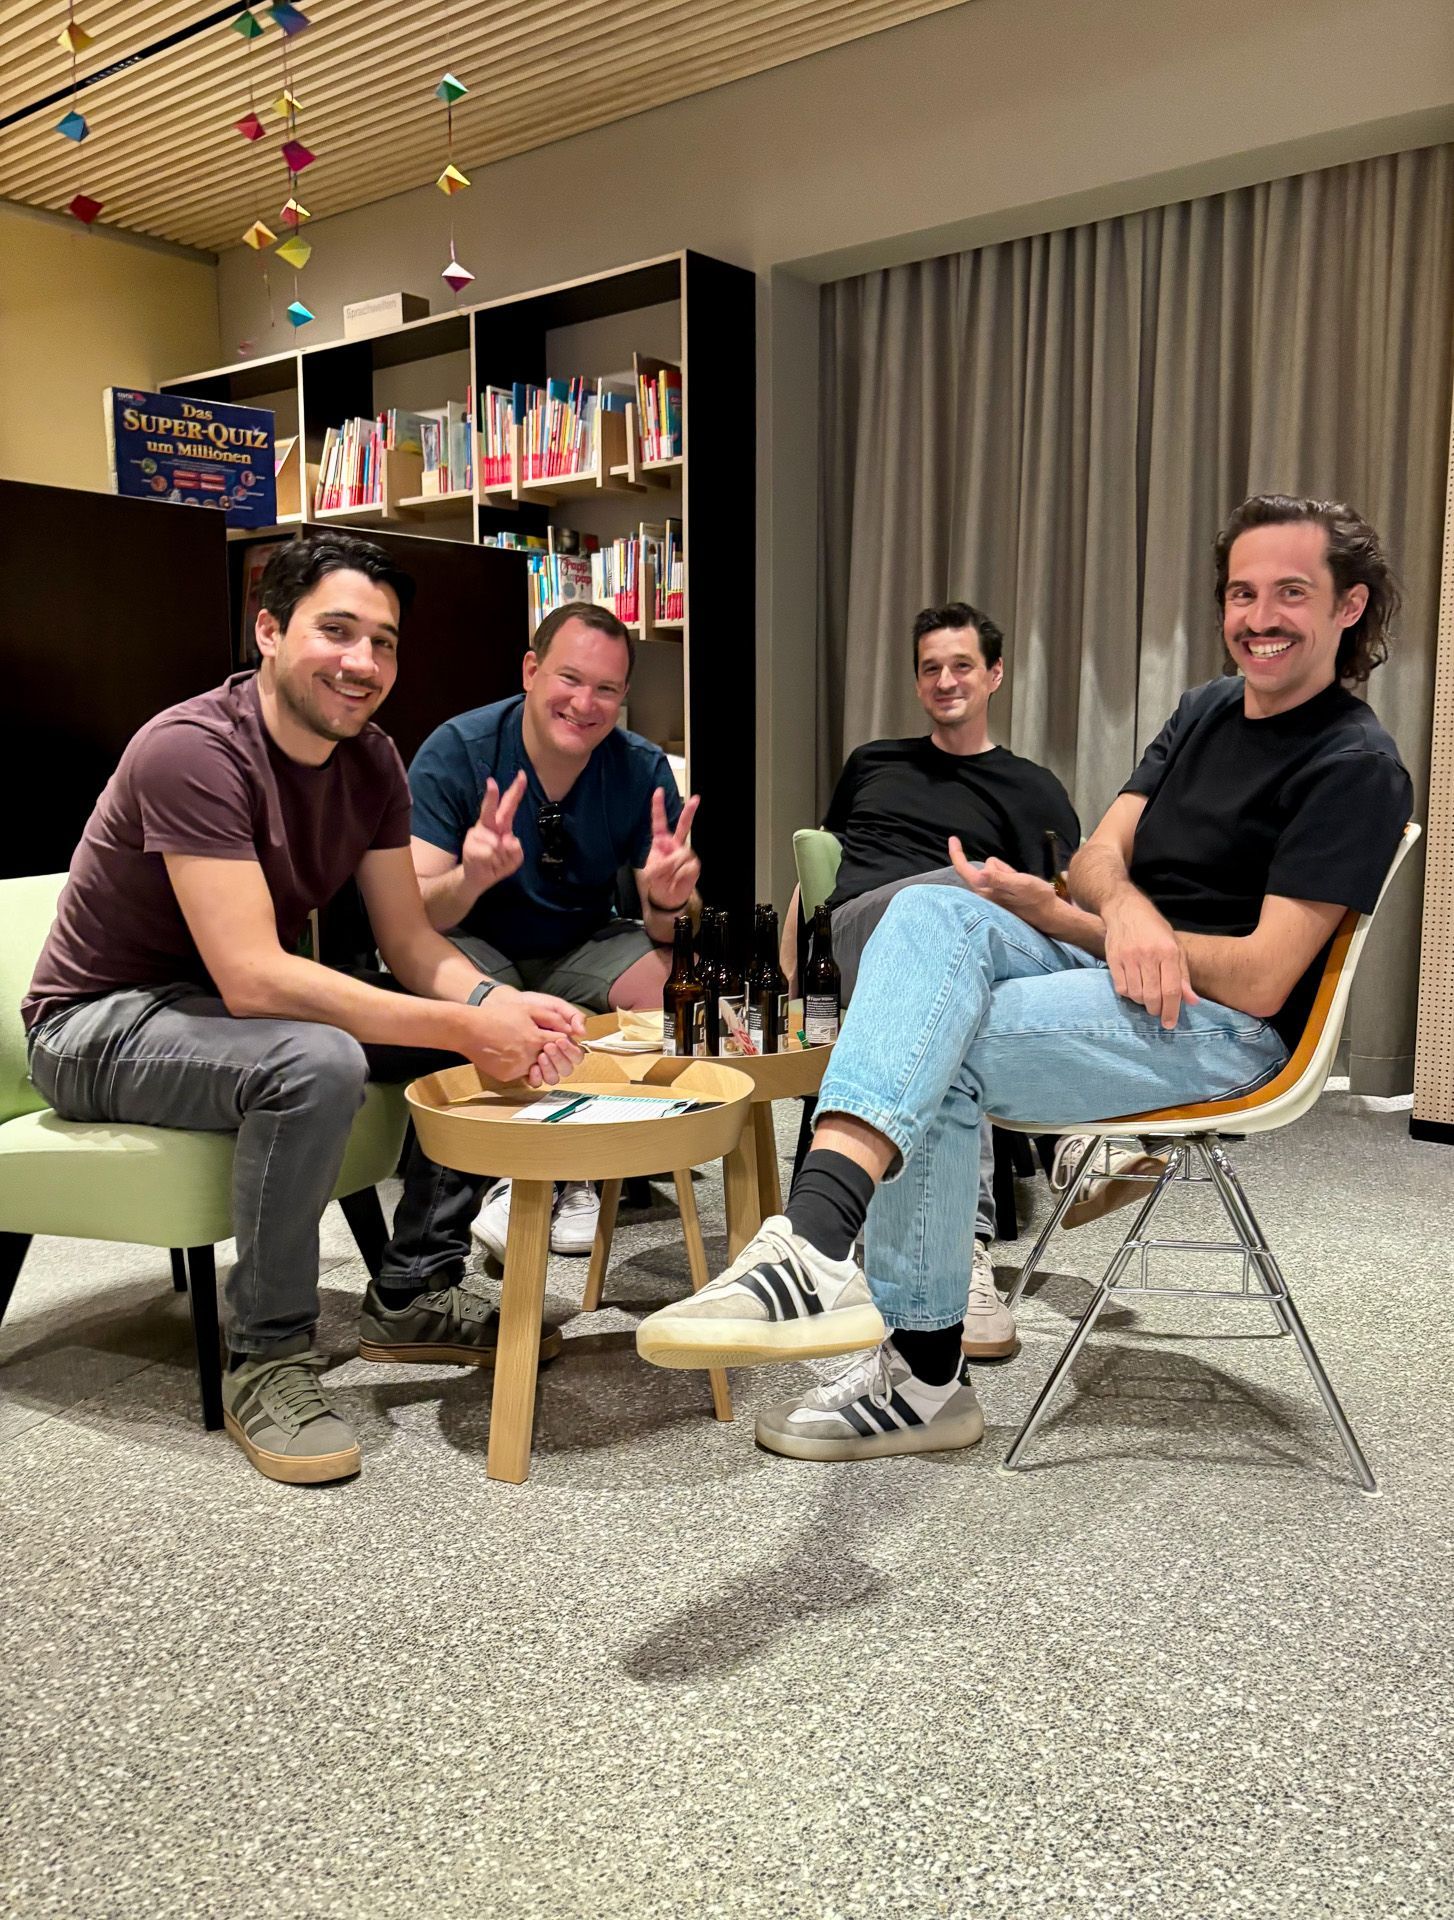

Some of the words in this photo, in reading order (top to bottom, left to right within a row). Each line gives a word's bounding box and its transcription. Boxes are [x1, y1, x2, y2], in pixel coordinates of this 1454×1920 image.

[182, 403, 213, 419] Das
[123, 407, 269, 449] SUPER-QUIZ
[147, 440, 174, 454] um
[177, 441, 252, 465] Millionen
